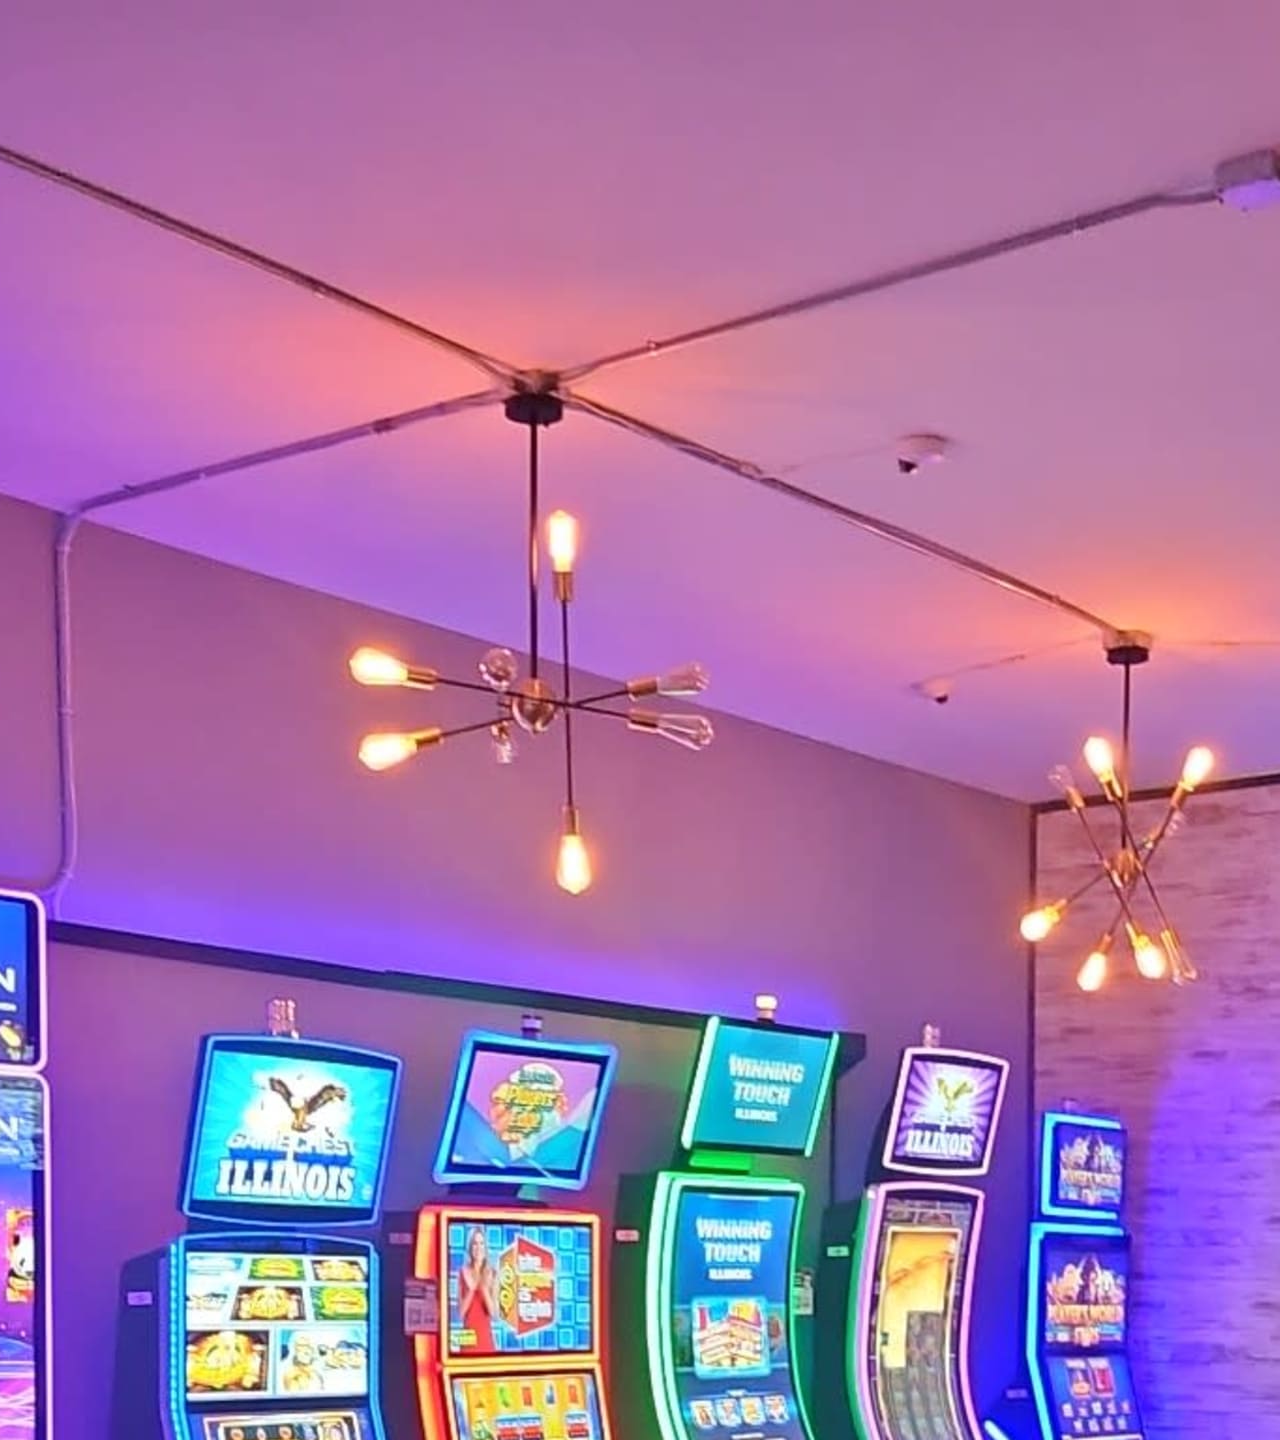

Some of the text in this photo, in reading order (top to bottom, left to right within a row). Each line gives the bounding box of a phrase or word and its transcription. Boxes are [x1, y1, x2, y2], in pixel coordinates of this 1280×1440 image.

[728, 1053, 805, 1084] WINNING
[734, 1081, 791, 1106] TOUCH
[905, 1130, 975, 1158] ILLINOIS
[216, 1157, 356, 1201] ILLINOIS
[695, 1217, 773, 1240] WINNING
[704, 1243, 761, 1263] TOUCH
